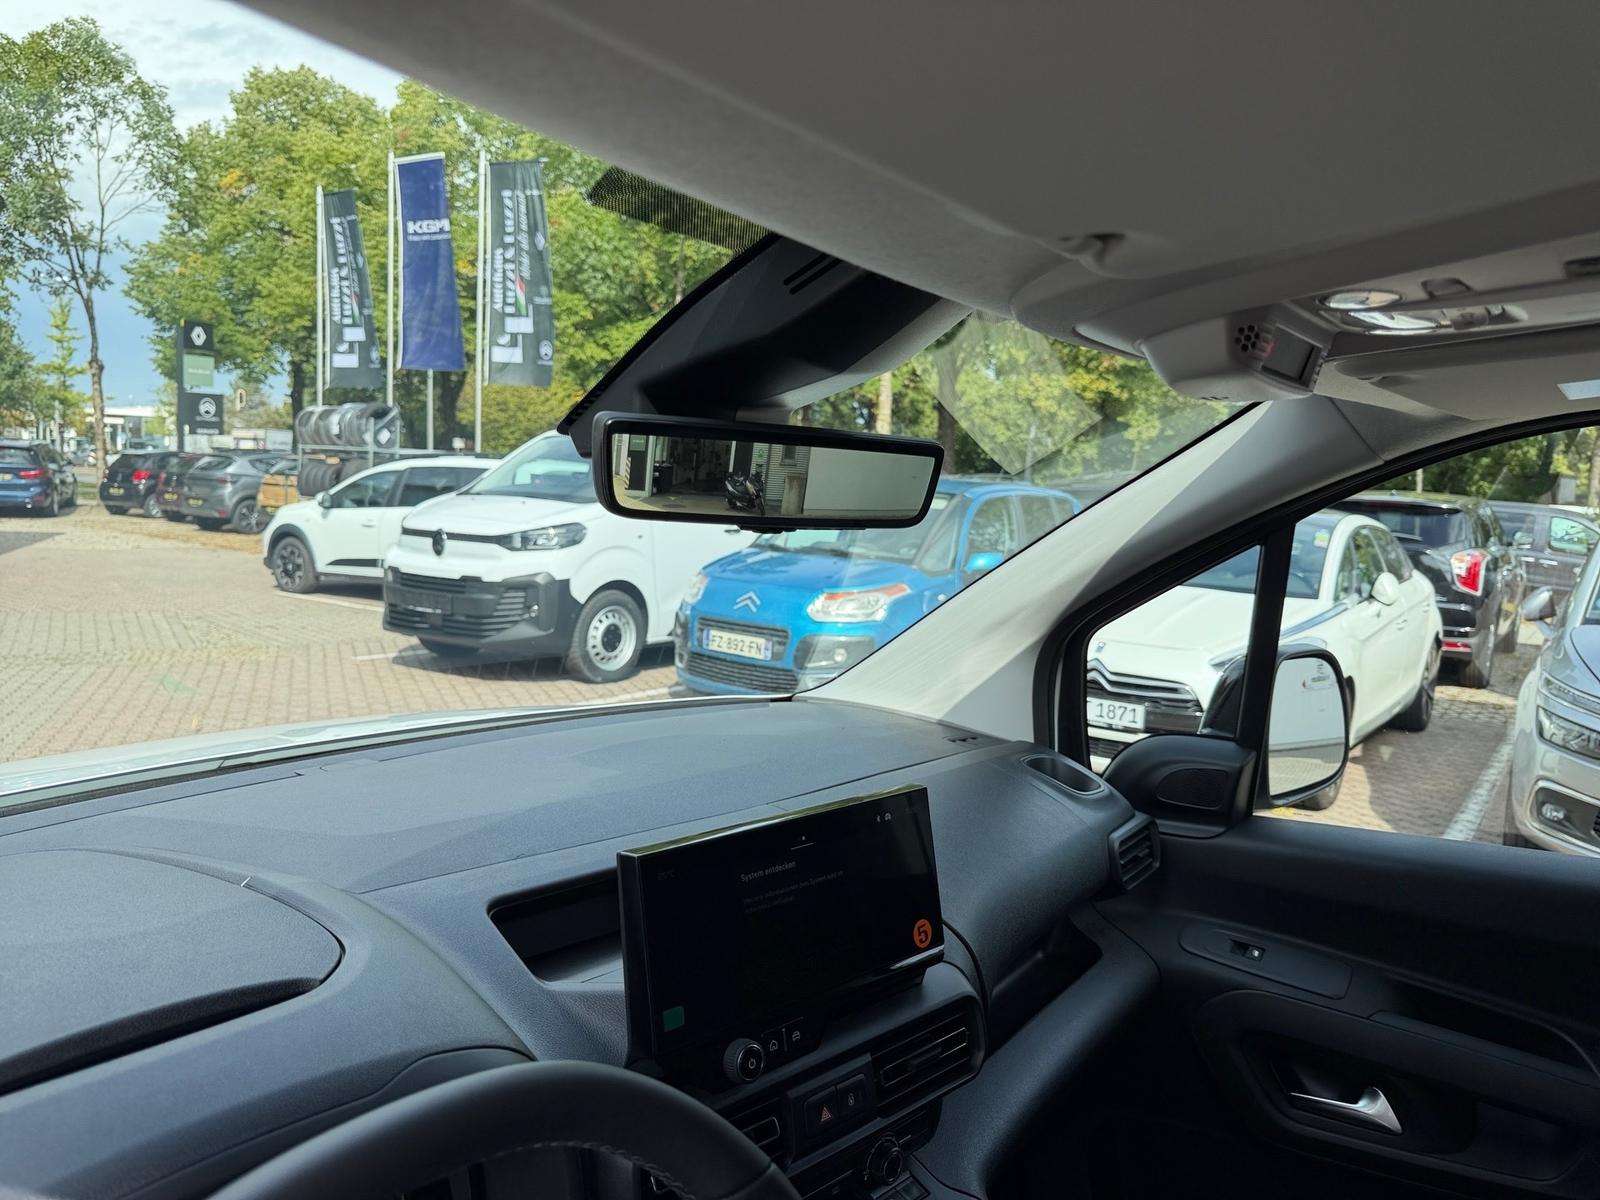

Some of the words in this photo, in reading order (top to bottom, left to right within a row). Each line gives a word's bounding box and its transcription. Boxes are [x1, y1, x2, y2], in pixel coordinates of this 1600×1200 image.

[407, 218, 450, 234] KGM
[1095, 702, 1137, 724] 1871
[740, 870, 765, 882] System
[917, 923, 930, 944] 5
